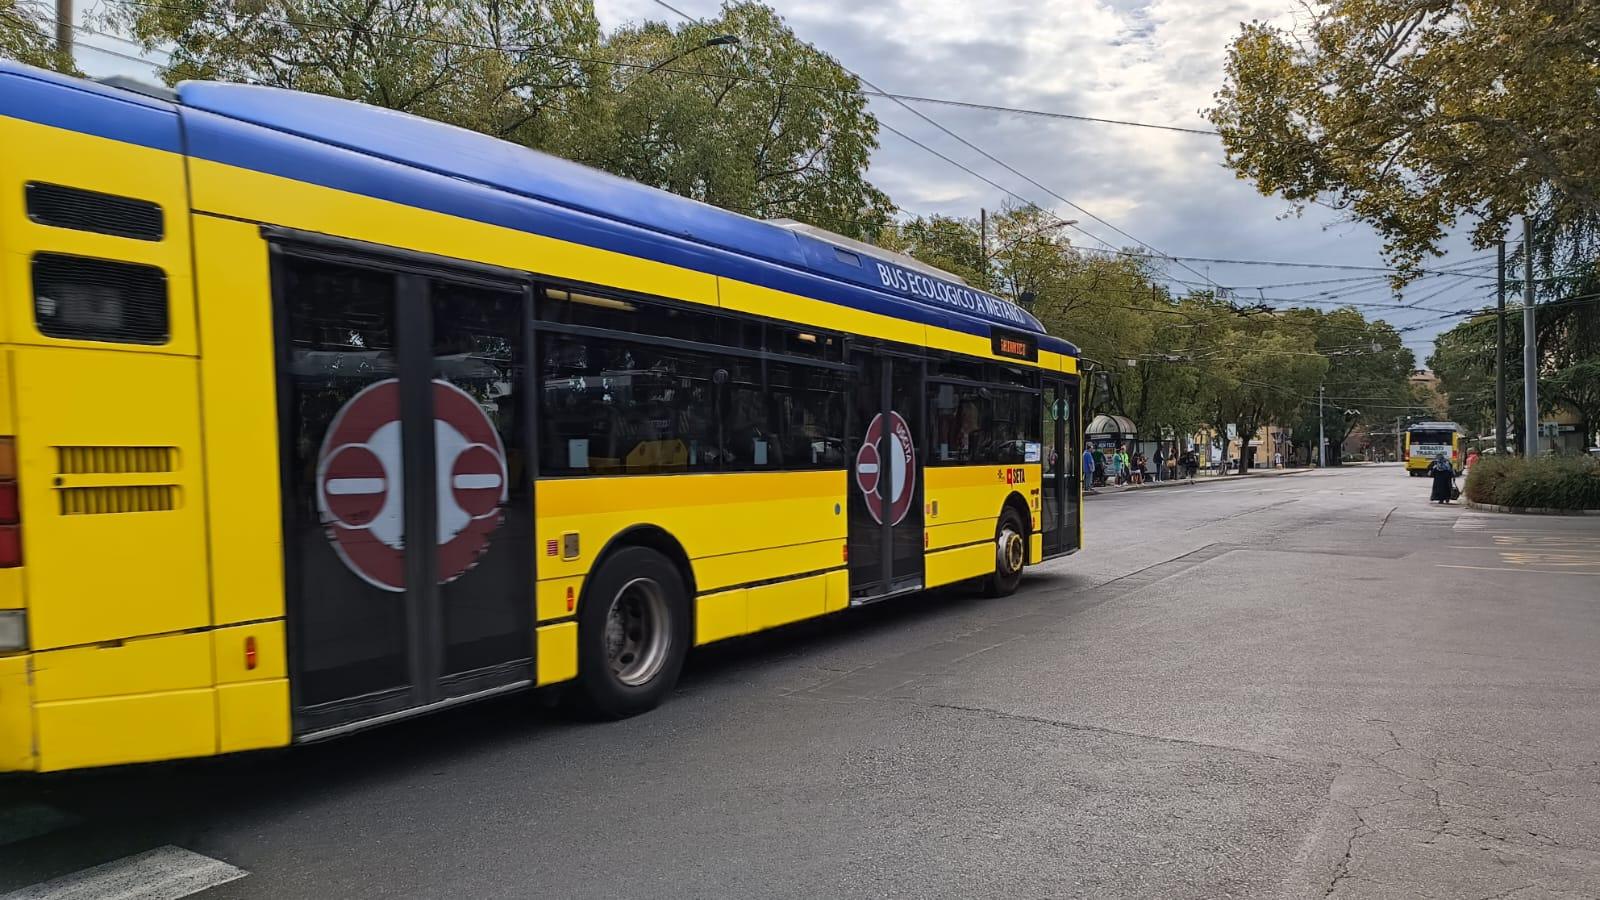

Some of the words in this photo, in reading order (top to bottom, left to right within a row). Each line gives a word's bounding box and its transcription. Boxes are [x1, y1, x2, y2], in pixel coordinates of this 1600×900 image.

[877, 263, 907, 290] BUS
[907, 272, 975, 310] ECOLOGICO
[974, 294, 986, 313] A
[896, 422, 912, 464] USCITA
[1013, 468, 1025, 484] SETA
